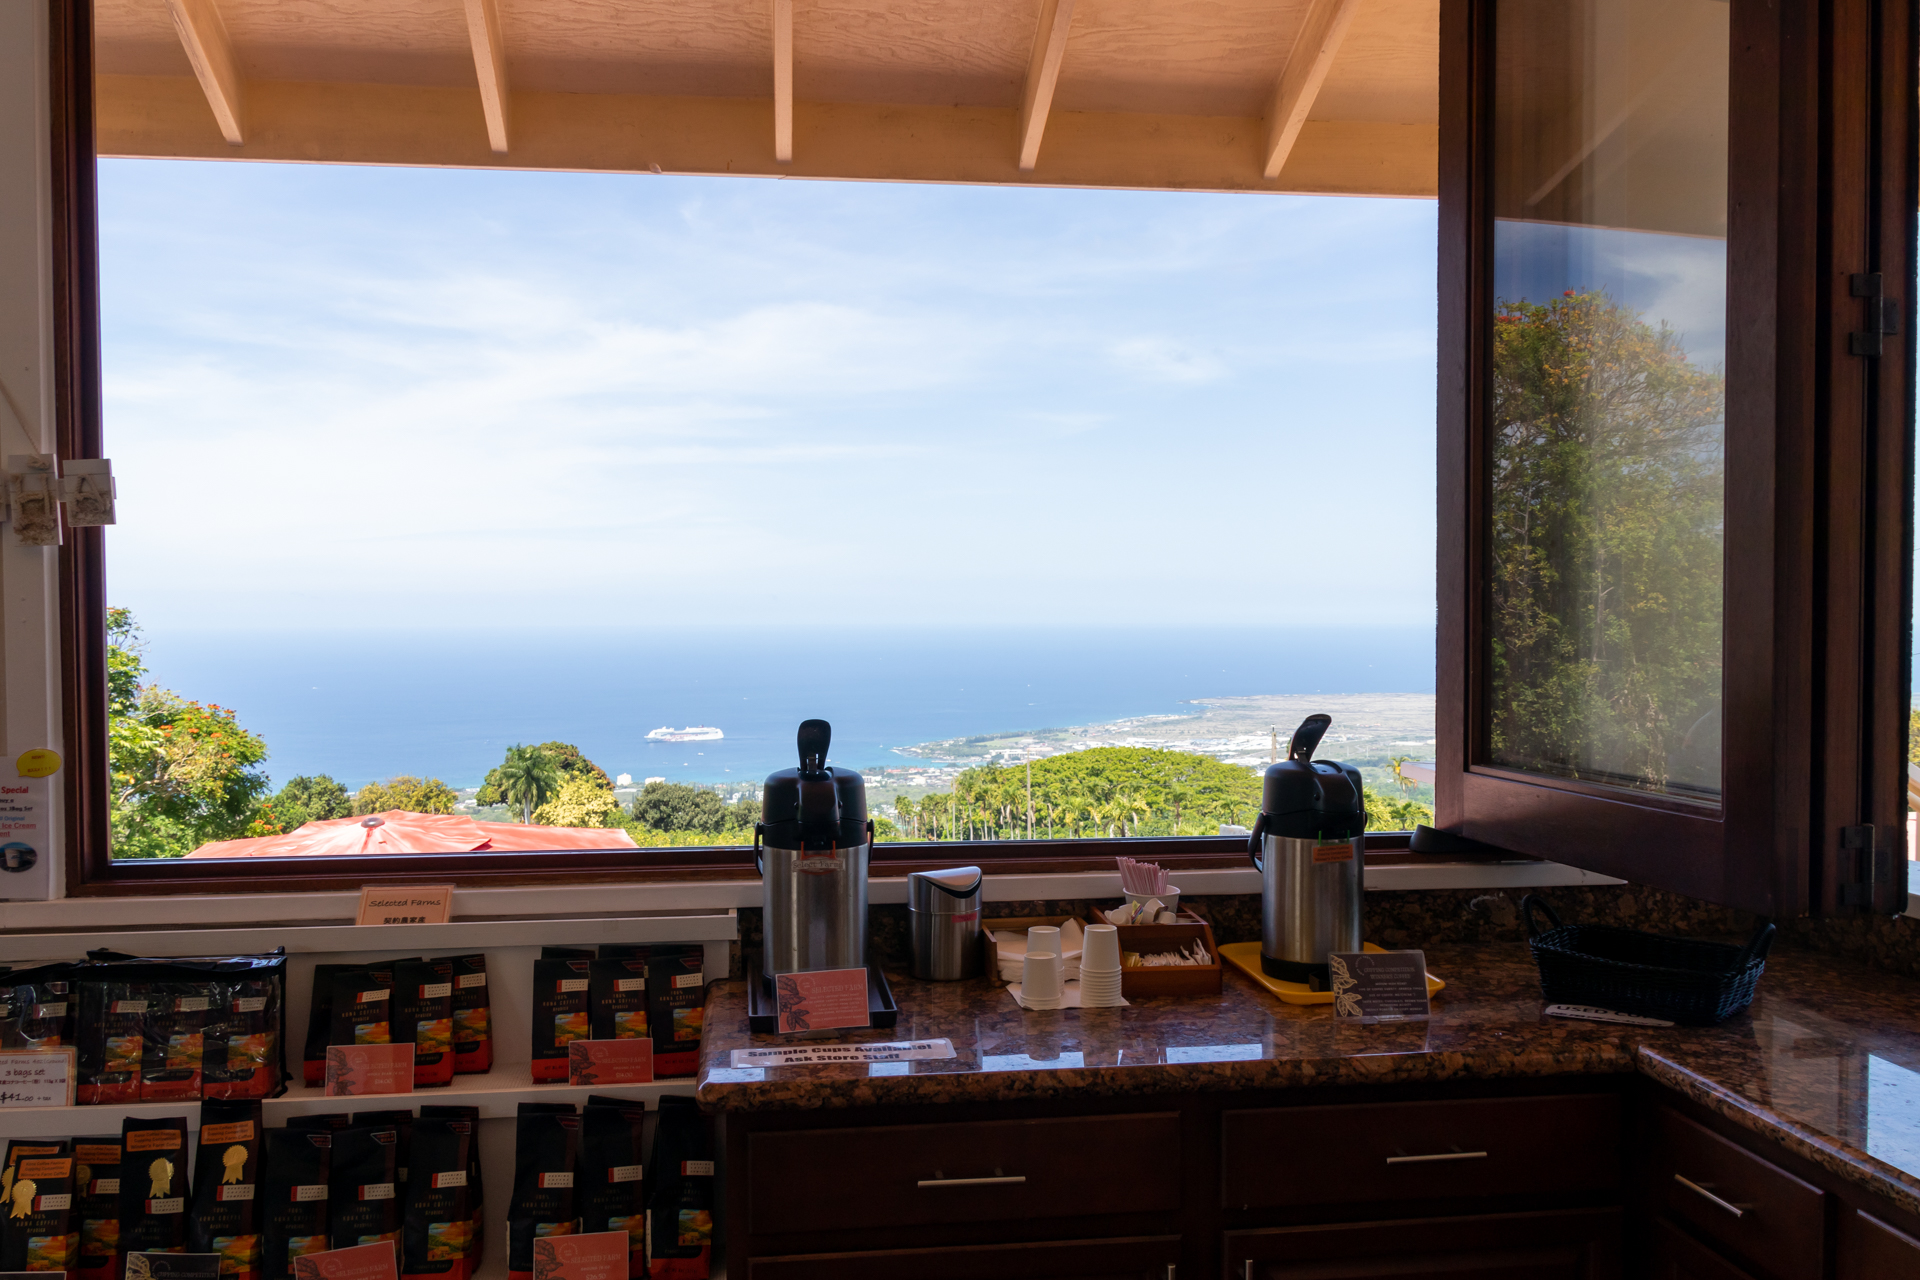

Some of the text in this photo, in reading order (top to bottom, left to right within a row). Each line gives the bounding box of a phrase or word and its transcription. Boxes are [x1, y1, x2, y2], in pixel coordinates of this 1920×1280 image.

[1, 786, 28, 794] Special
[368, 899, 408, 907] Selected
[1557, 1005, 1607, 1014] USED
[748, 1049, 808, 1057] Sample
[14, 1069, 32, 1078] bags
[0, 1092, 34, 1104] $41.00
[571, 1255, 602, 1263] SELECTED
[336, 1263, 388, 1277] SELECTED FARM
